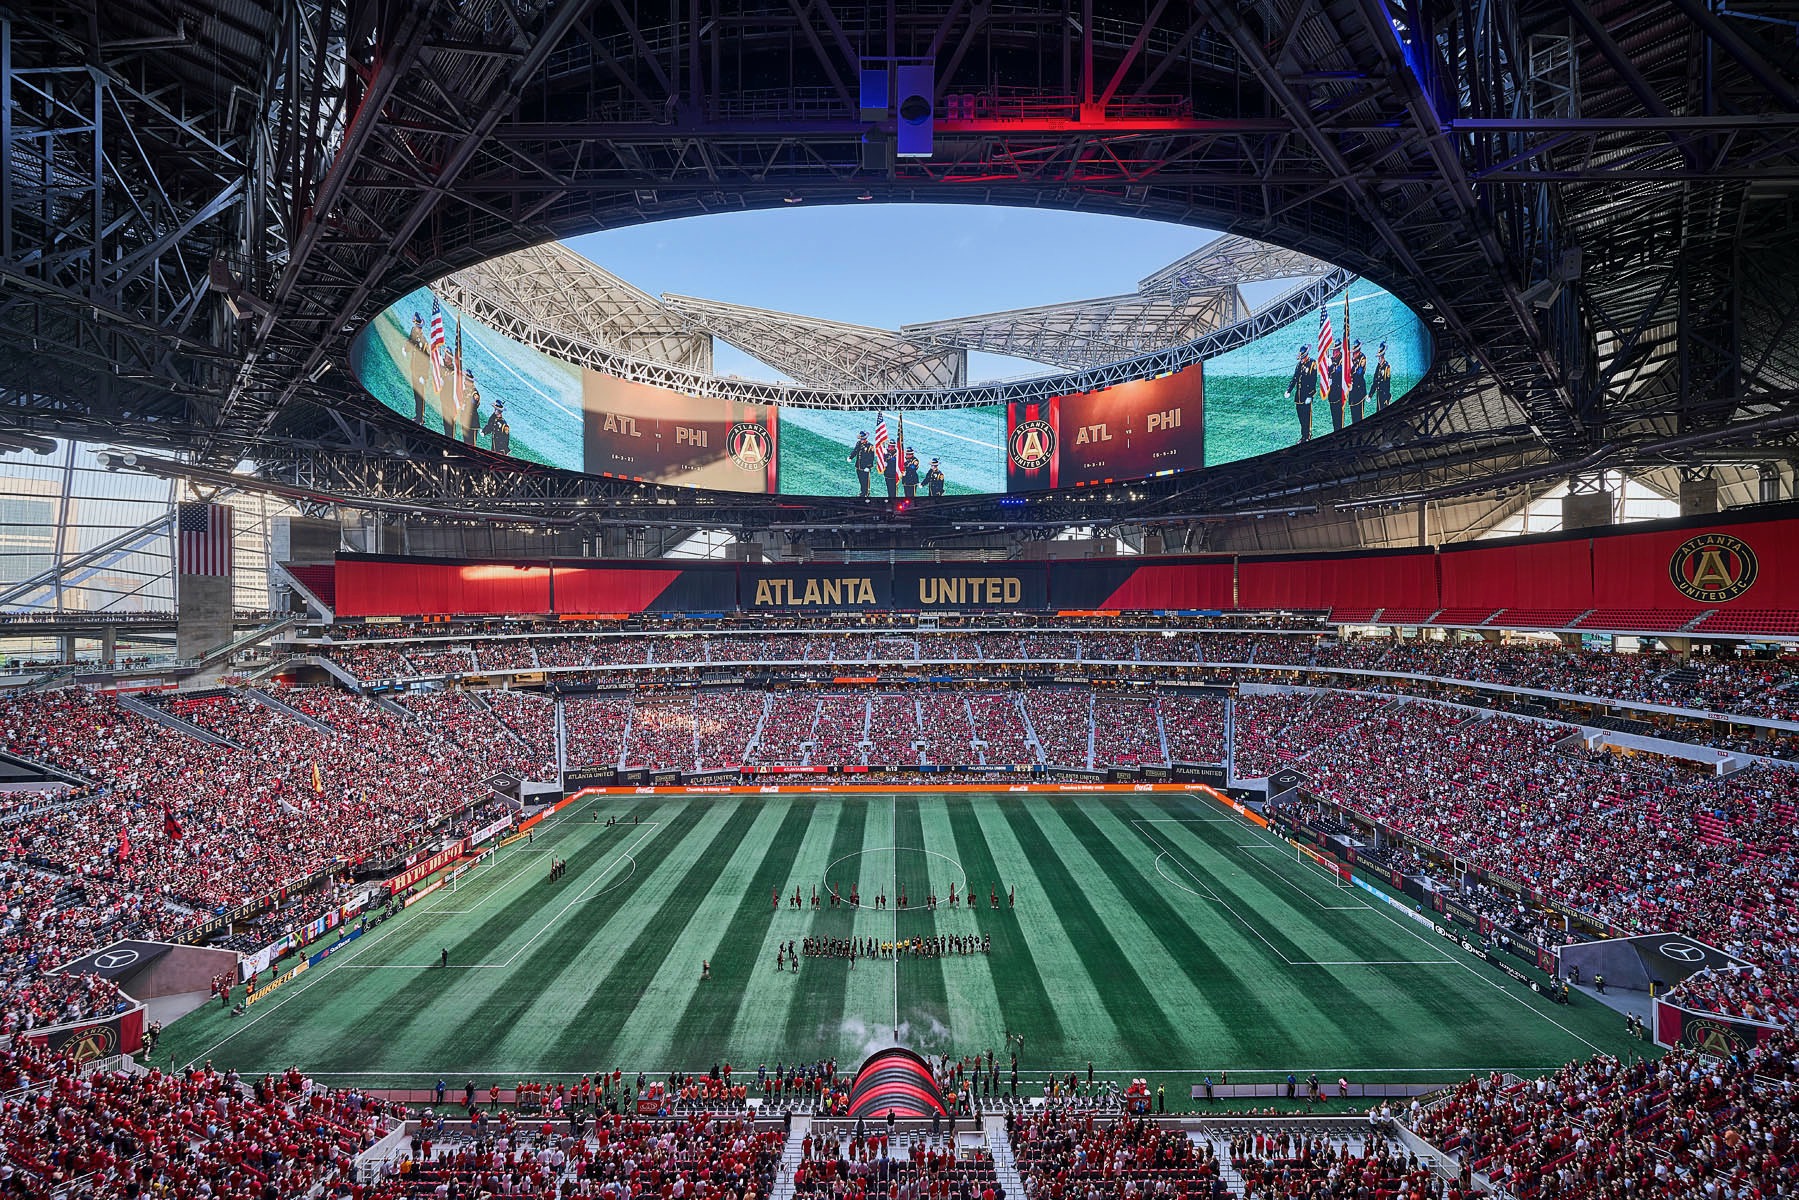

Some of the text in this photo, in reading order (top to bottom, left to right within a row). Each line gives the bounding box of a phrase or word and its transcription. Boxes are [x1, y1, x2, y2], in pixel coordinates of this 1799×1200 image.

[603, 412, 641, 438] ATL
[734, 424, 767, 437] ATLANTA
[1017, 421, 1049, 434] ATLANTA
[1147, 408, 1181, 433] PHI
[676, 426, 709, 448] PHI
[1076, 423, 1113, 445] ATL
[732, 454, 758, 470] UNITED
[1014, 454, 1041, 468] UNITED
[1681, 535, 1742, 555] ATLANTA
[754, 577, 1021, 605] ATLANTA UNITED
[1680, 580, 1748, 600] UNITED FC
[594, 770, 615, 778] UNITED
[1201, 769, 1223, 777] UNITED
[393, 862, 428, 891] HYPE
[429, 842, 464, 871] DEPOT
[1357, 855, 1391, 878] ATLANTA UNITED
[177, 900, 265, 945] RESURGENCE
[286, 876, 313, 894] ROWDY
[1551, 901, 1604, 930] ATLANTA UNITED
[1472, 948, 1487, 960] NCR
[1516, 942, 1536, 957] UNITED
[247, 971, 295, 1006] QUIKRETE
